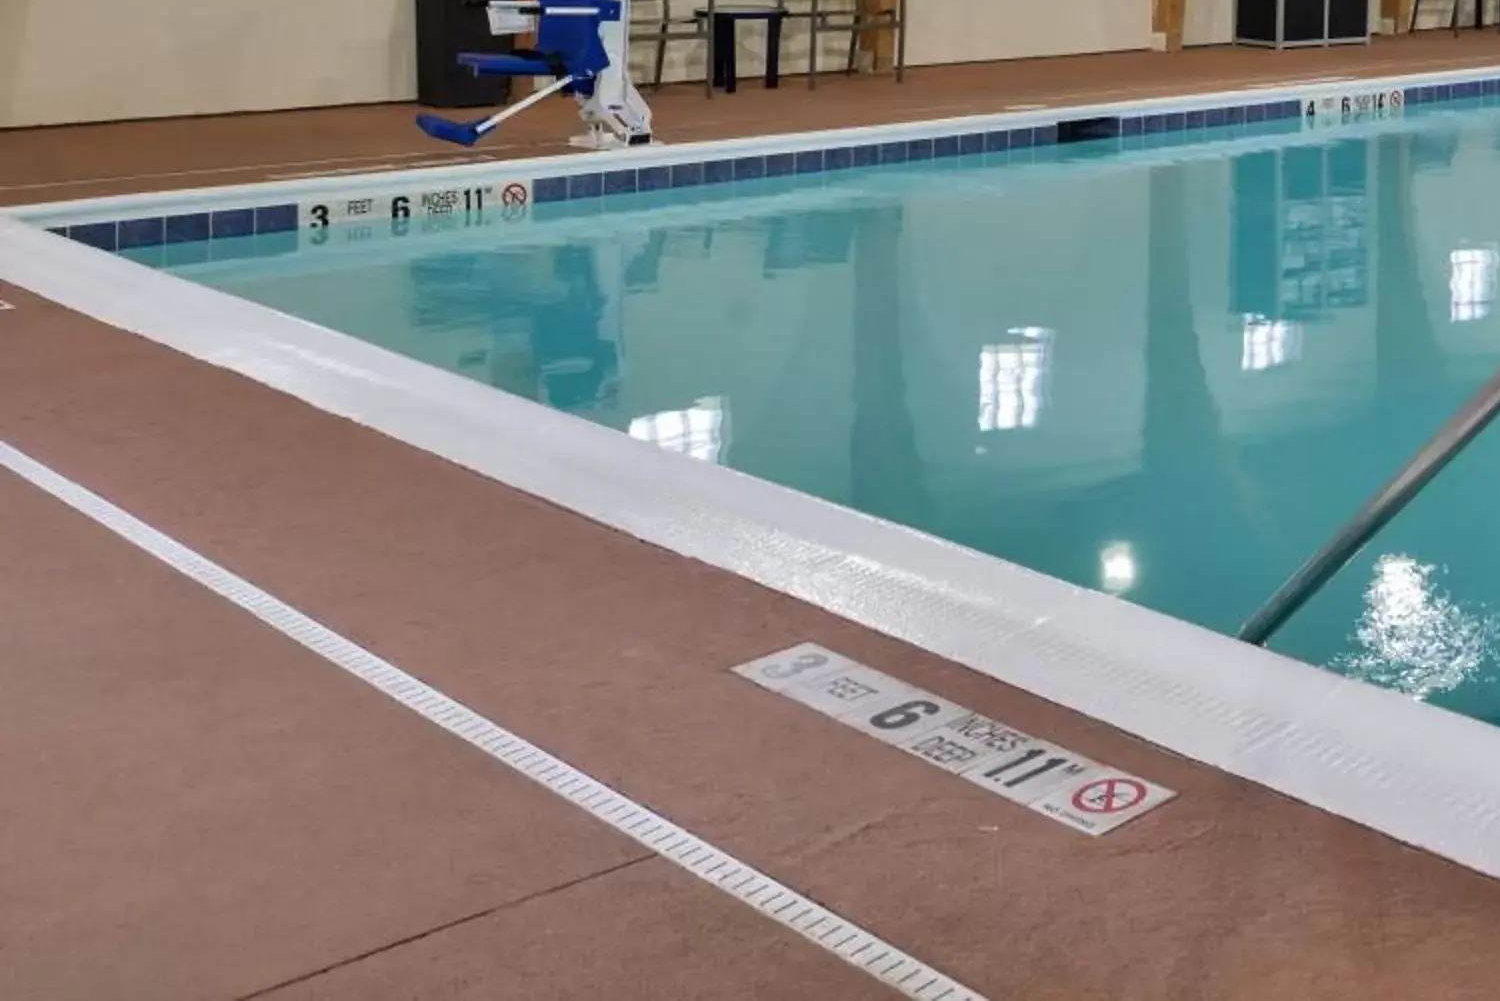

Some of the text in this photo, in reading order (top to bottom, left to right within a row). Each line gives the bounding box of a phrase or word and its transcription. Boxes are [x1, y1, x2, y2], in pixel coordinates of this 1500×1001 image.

[309, 204, 329, 228] 3
[391, 195, 411, 218] 6
[760, 653, 830, 680] 3
[827, 676, 880, 701] FEET
[869, 699, 941, 730] 6
[954, 715, 1030, 753] NCHES
[911, 735, 977, 764] DEEP
